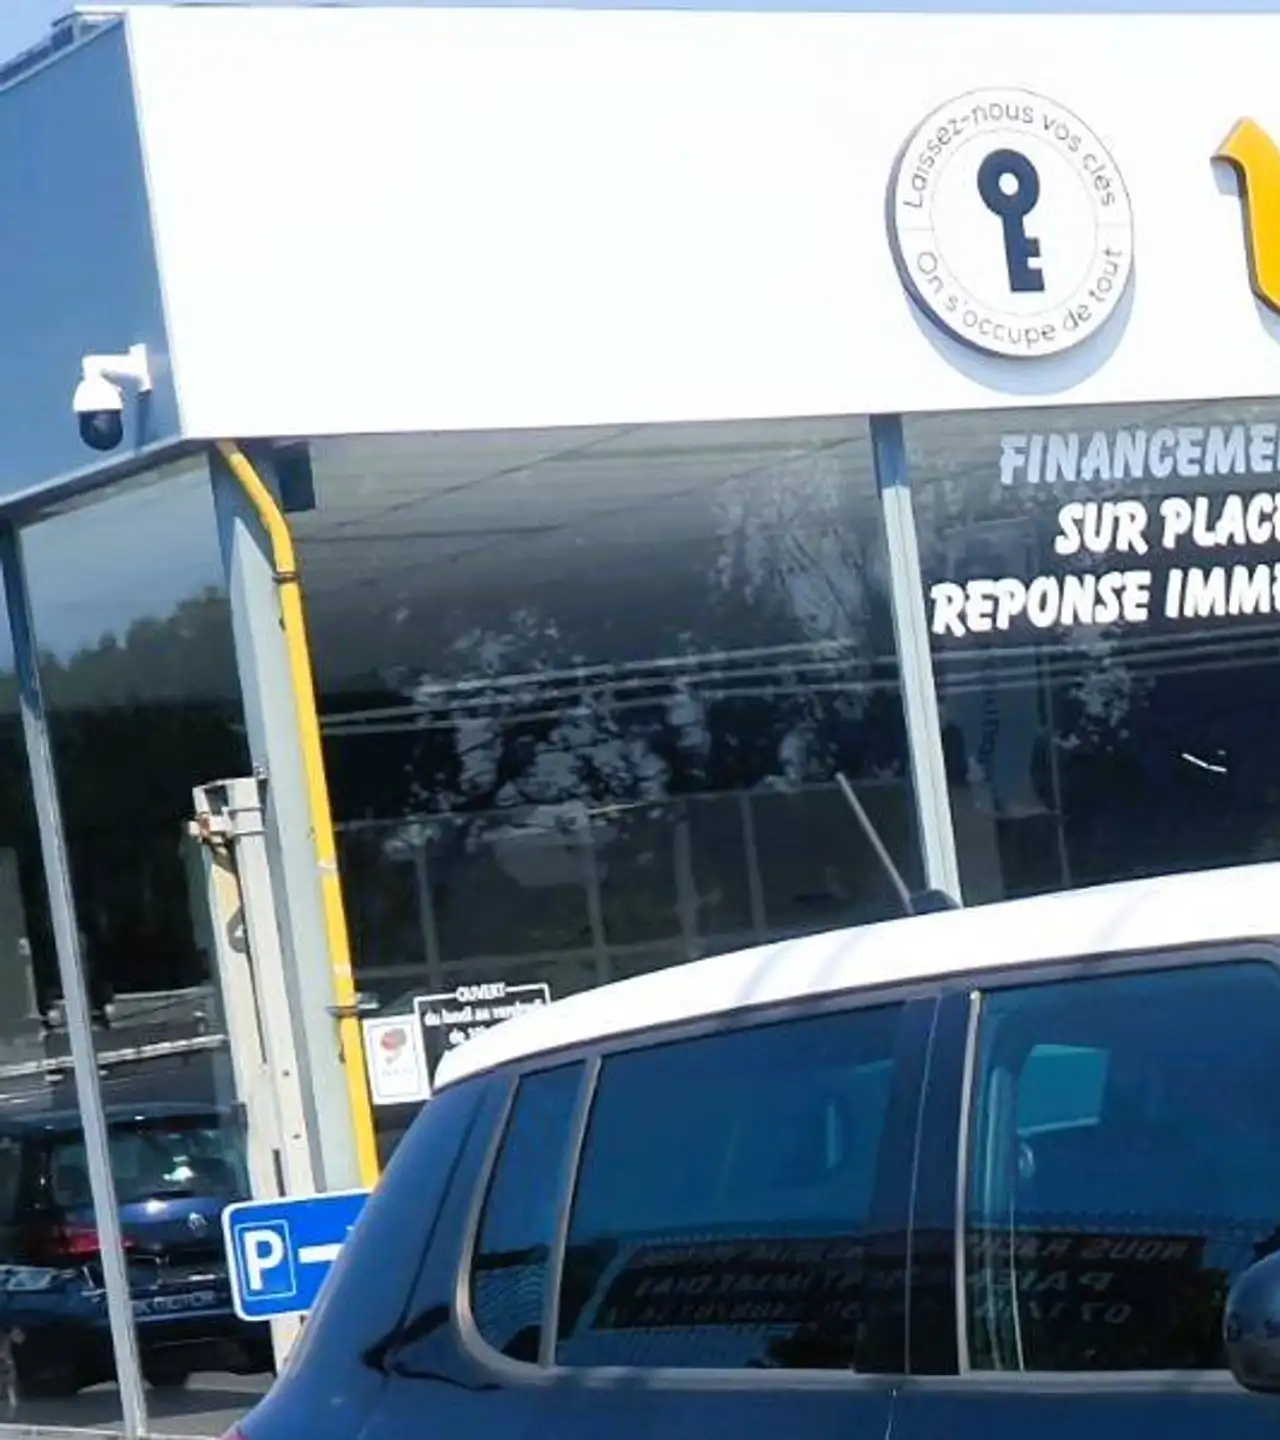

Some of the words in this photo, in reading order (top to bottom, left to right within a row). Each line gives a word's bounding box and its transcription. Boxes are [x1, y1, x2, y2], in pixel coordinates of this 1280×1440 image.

[903, 102, 1034, 209] Laissez-nous
[1042, 113, 1082, 153] vos
[1082, 152, 1116, 207] clés
[917, 250, 945, 294] On
[947, 293, 1056, 348] s'occupe
[1062, 303, 1093, 332] de
[1088, 246, 1123, 303] tout
[1054, 500, 1149, 555] SUR
[930, 569, 1152, 637] REPONSE
[455, 981, 507, 1003] OUVERT
[243, 1229, 286, 1290] P
